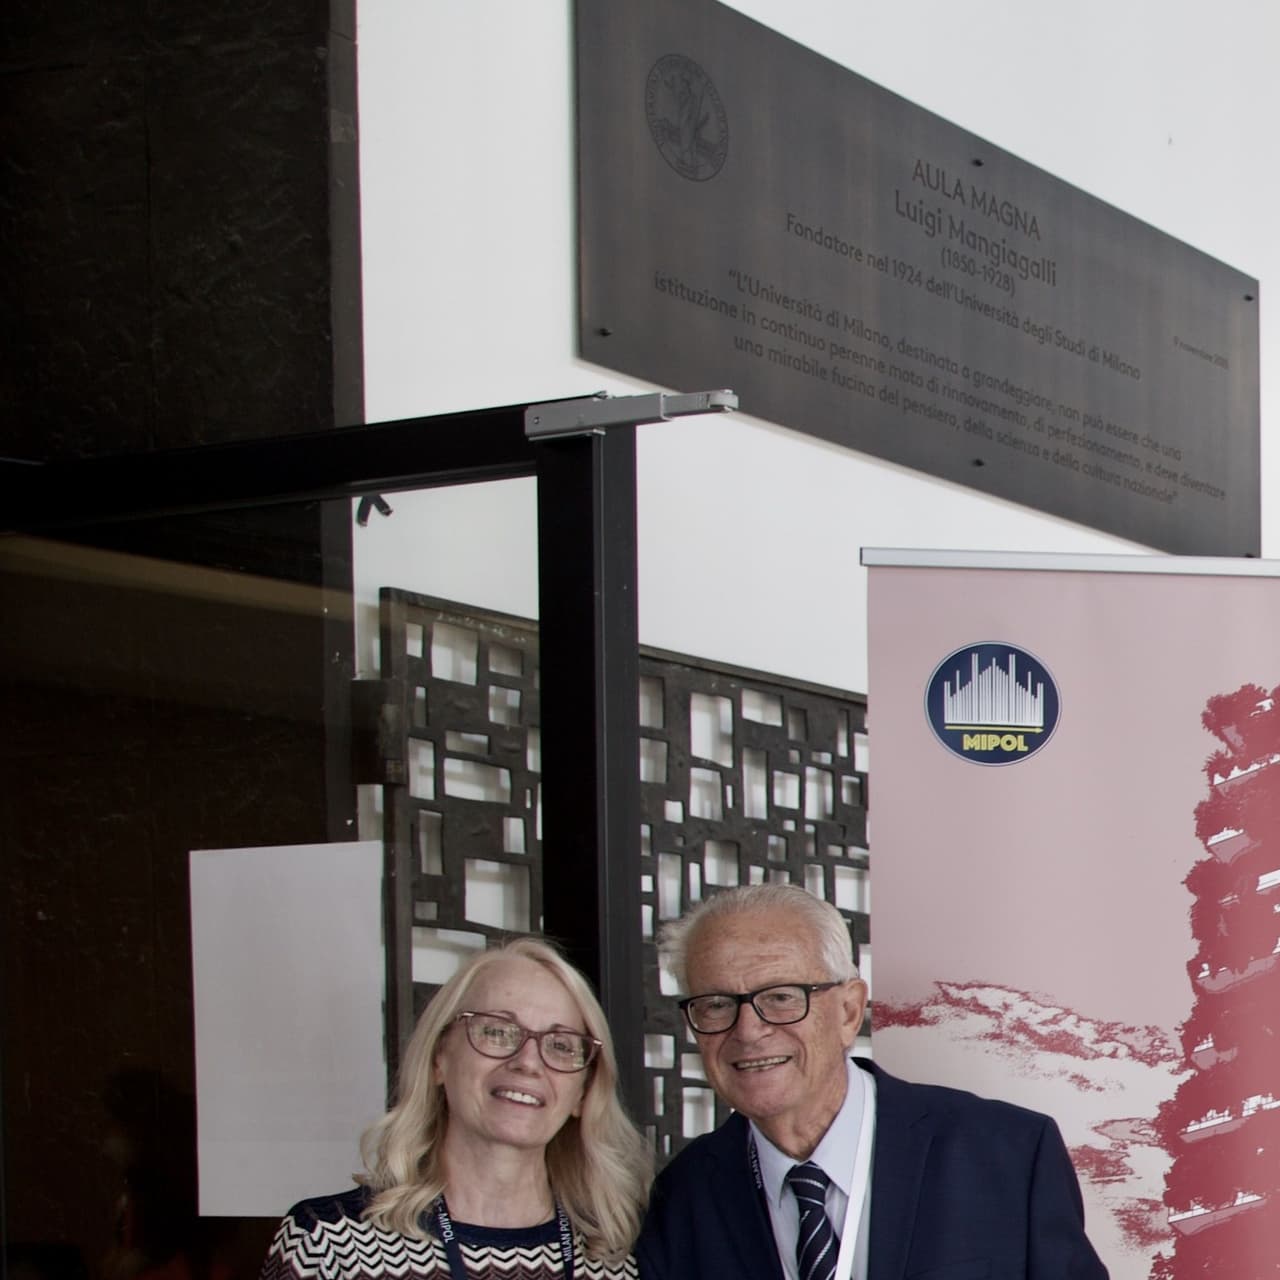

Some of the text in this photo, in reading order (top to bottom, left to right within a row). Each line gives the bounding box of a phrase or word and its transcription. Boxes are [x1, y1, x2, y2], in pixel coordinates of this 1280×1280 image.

[896, 189, 1056, 287] Luigi Mangiagalli
[912, 159, 1041, 241] AULA MAGNA
[655, 270, 738, 319] istituzione
[742, 303, 756, 325] in
[761, 317, 825, 351] continuo
[830, 342, 886, 374] perenne
[889, 363, 924, 388] moto
[927, 377, 939, 394] di
[787, 213, 863, 262] Fondatore
[867, 252, 889, 274] nel
[893, 259, 922, 287] 1924
[1023, 316, 1052, 344] degli
[1055, 329, 1086, 356] Studi
[1088, 345, 1100, 362] di
[1102, 350, 1140, 380] Milano
[734, 335, 763, 357] una
[768, 348, 827, 379] mirabile
[832, 366, 875, 397] fucina
[879, 386, 899, 405] del
[827, 311, 839, 328] di
[845, 315, 893, 350] Milano,
[897, 338, 958, 374] destinata
[962, 365, 970, 379] a
[1058, 404, 1080, 422] non
[963, 733, 1029, 752] MIPOL
[438, 1212, 455, 1243] MIPOL
[560, 1233, 572, 1262] MILAN
